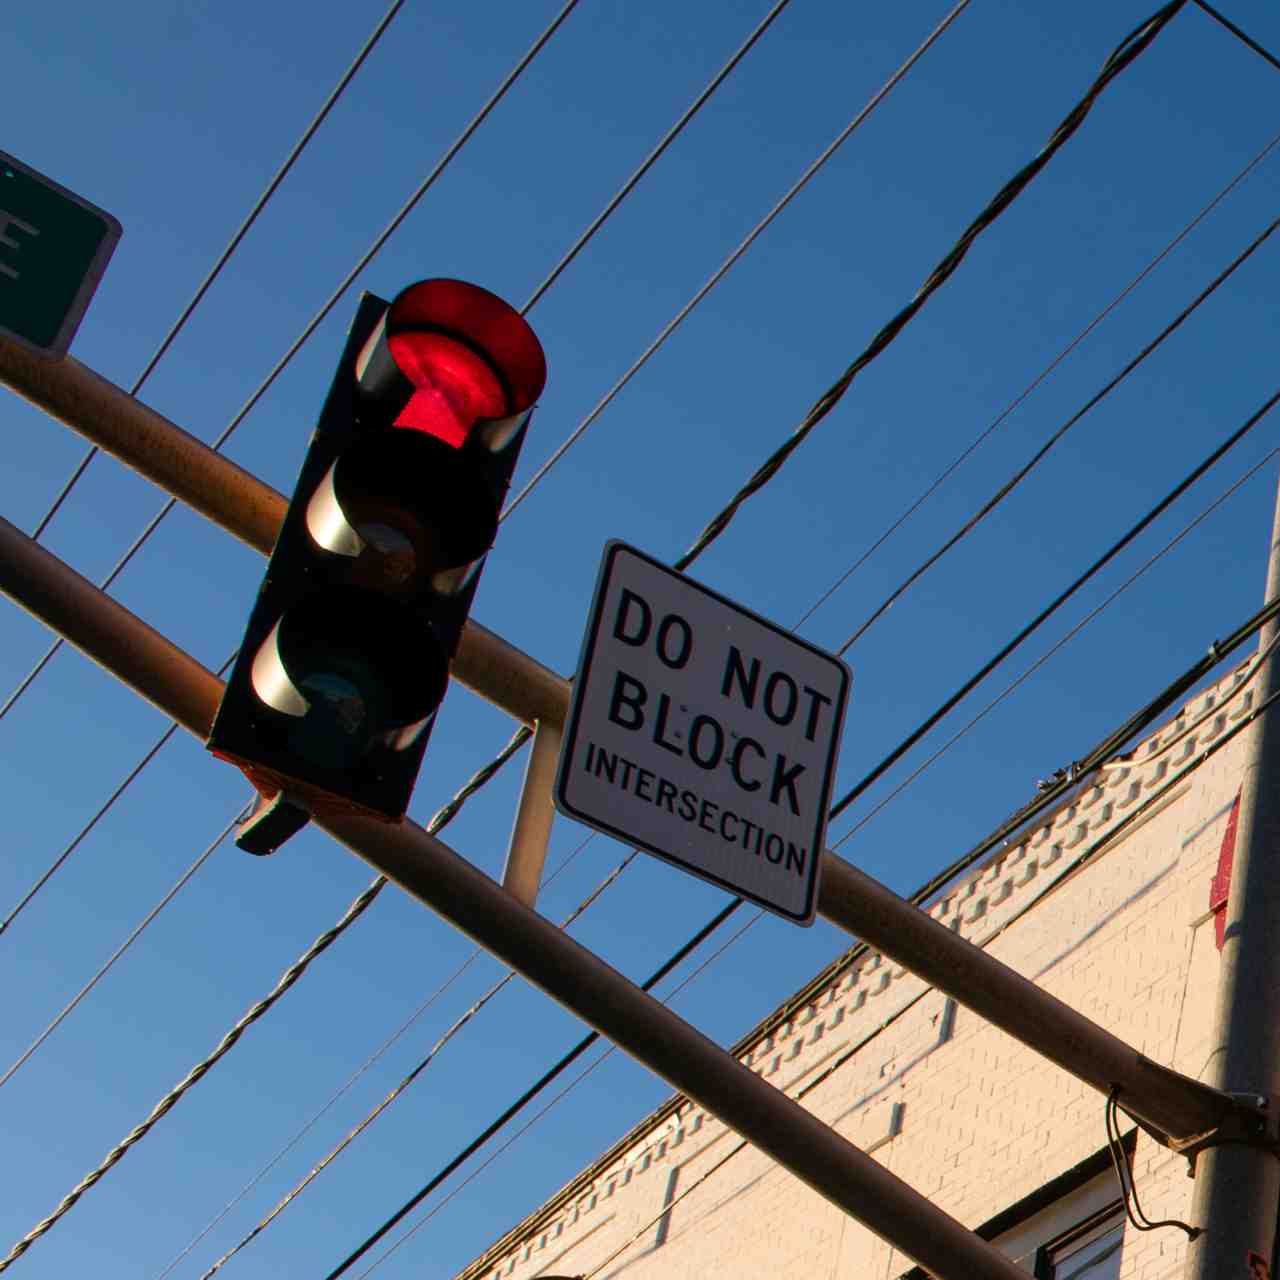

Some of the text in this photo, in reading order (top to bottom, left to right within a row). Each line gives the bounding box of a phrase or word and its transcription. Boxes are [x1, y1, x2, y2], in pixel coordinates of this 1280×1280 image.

[612, 587, 832, 743] DO NOT
[583, 742, 807, 877] INTERSECTION
[607, 669, 806, 817] BLOCK
